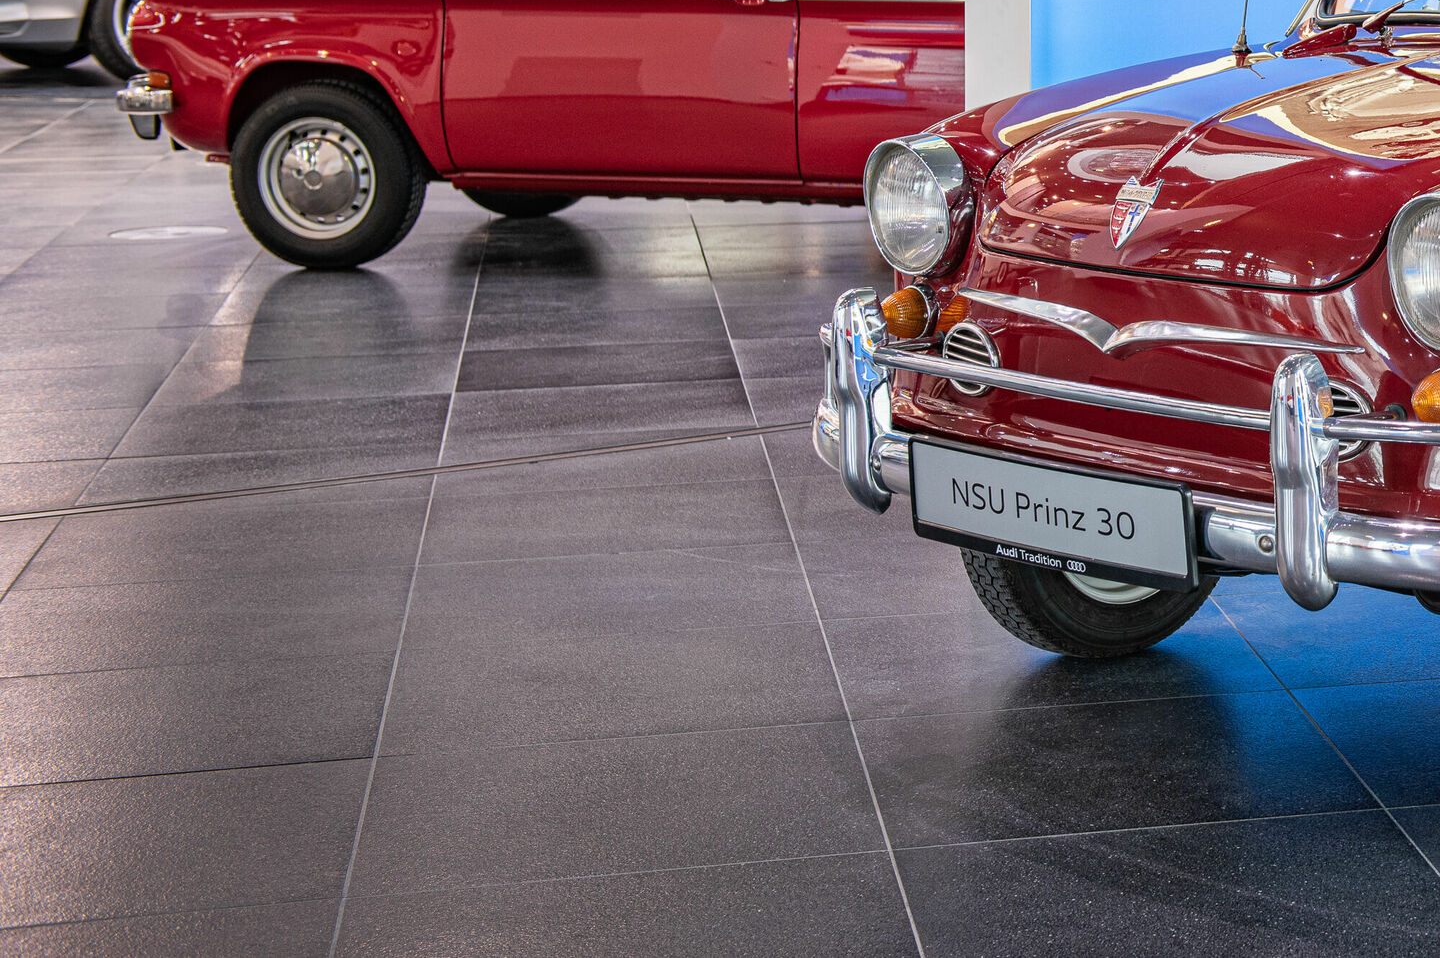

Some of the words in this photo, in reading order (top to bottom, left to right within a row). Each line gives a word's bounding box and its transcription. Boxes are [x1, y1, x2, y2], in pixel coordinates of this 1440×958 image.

[951, 477, 1005, 515] NSU
[1015, 491, 1087, 532] Prinz
[1096, 507, 1136, 540] 30
[995, 544, 1019, 559] Audi
[1019, 549, 1063, 569] Tradition
